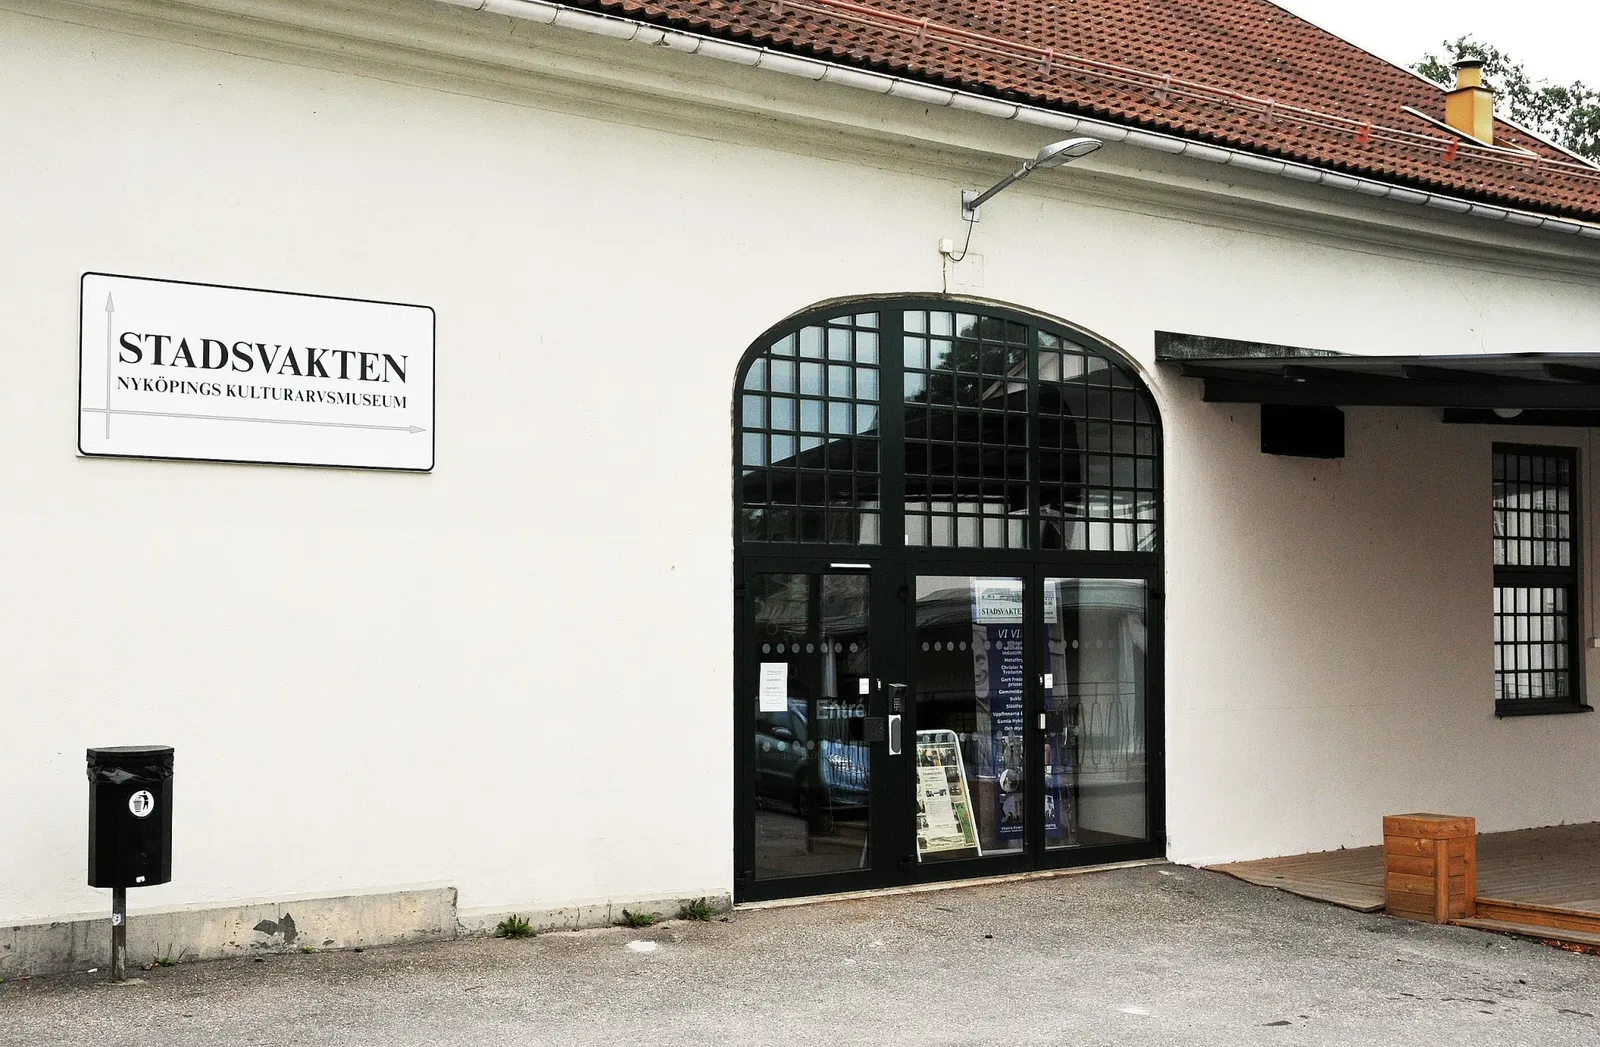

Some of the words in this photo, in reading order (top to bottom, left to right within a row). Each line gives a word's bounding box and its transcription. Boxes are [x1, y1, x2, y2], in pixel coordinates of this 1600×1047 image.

[118, 331, 409, 384] STADSVAKTEN
[117, 376, 222, 397] NYKÖPINGS
[226, 384, 407, 409] KULTURARVSMUSEUM
[998, 629, 1008, 638] VI
[816, 698, 865, 719] Entré
